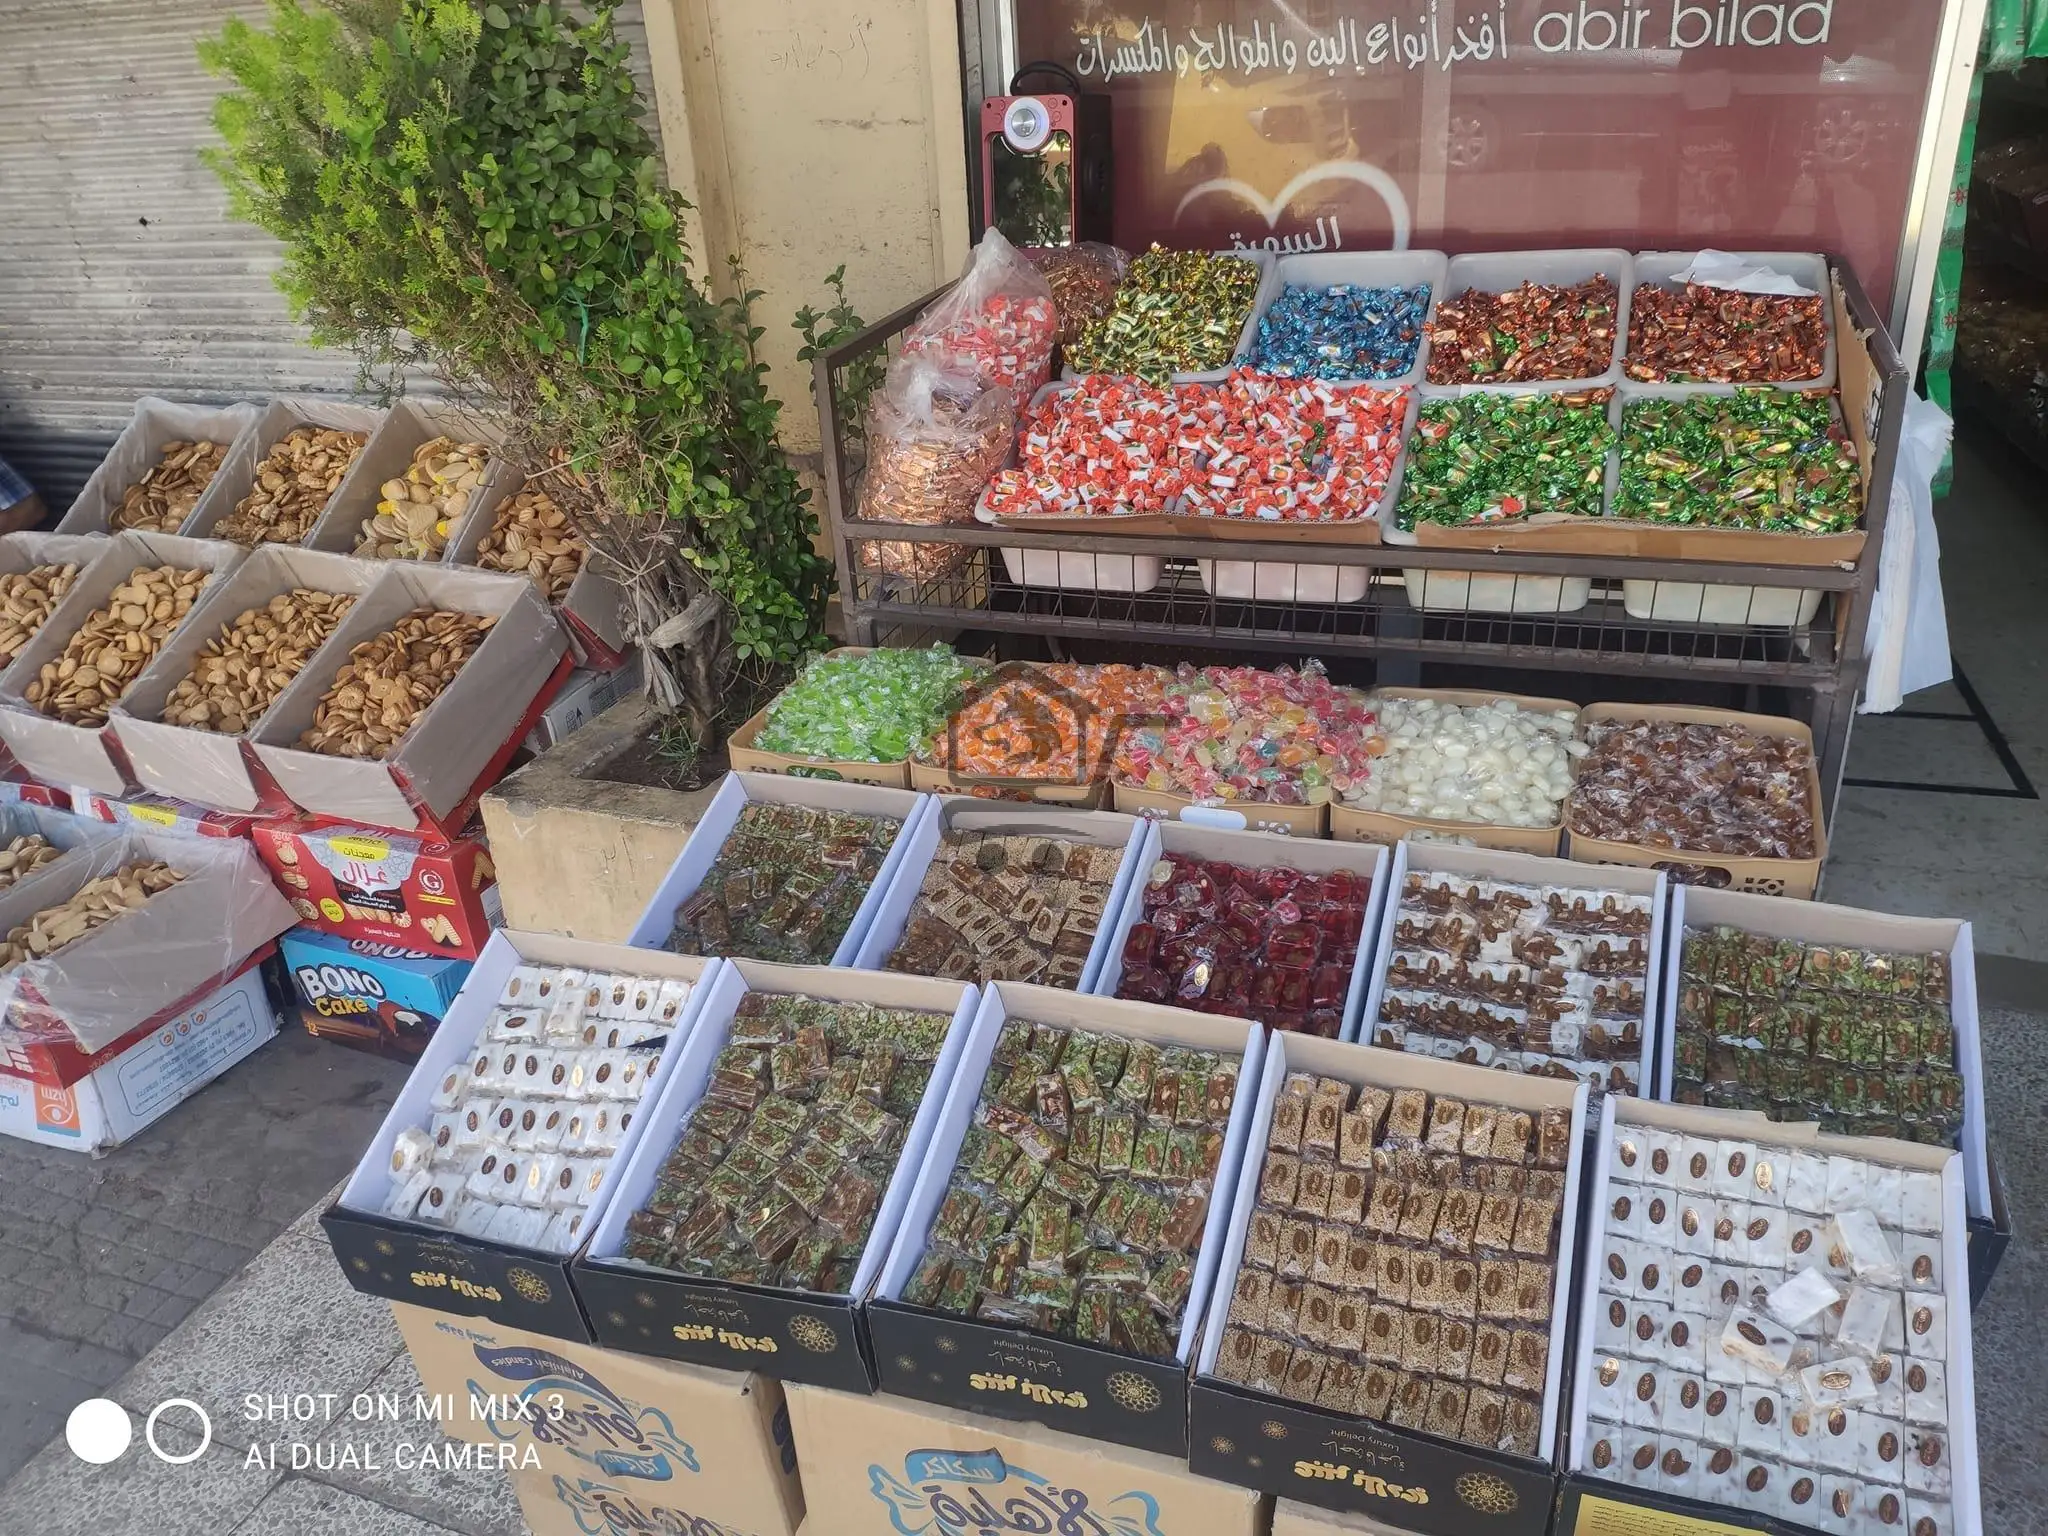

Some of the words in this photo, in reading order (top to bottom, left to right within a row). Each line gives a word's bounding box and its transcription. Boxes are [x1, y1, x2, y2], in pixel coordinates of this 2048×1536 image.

[1365, 0, 1440, 71] أنواع
[1441, 0, 1508, 72] أفخر
[1532, 0, 1651, 53] abir
[1669, 0, 1835, 48] bilad
[1075, 15, 1189, 84] والمكسرات
[297, 966, 384, 999] BONO
[315, 996, 369, 1017] Cake
[490, 1356, 533, 1367] Candies
[1329, 1428, 1366, 1444] Delight
[1367, 1435, 1400, 1453] Luxury
